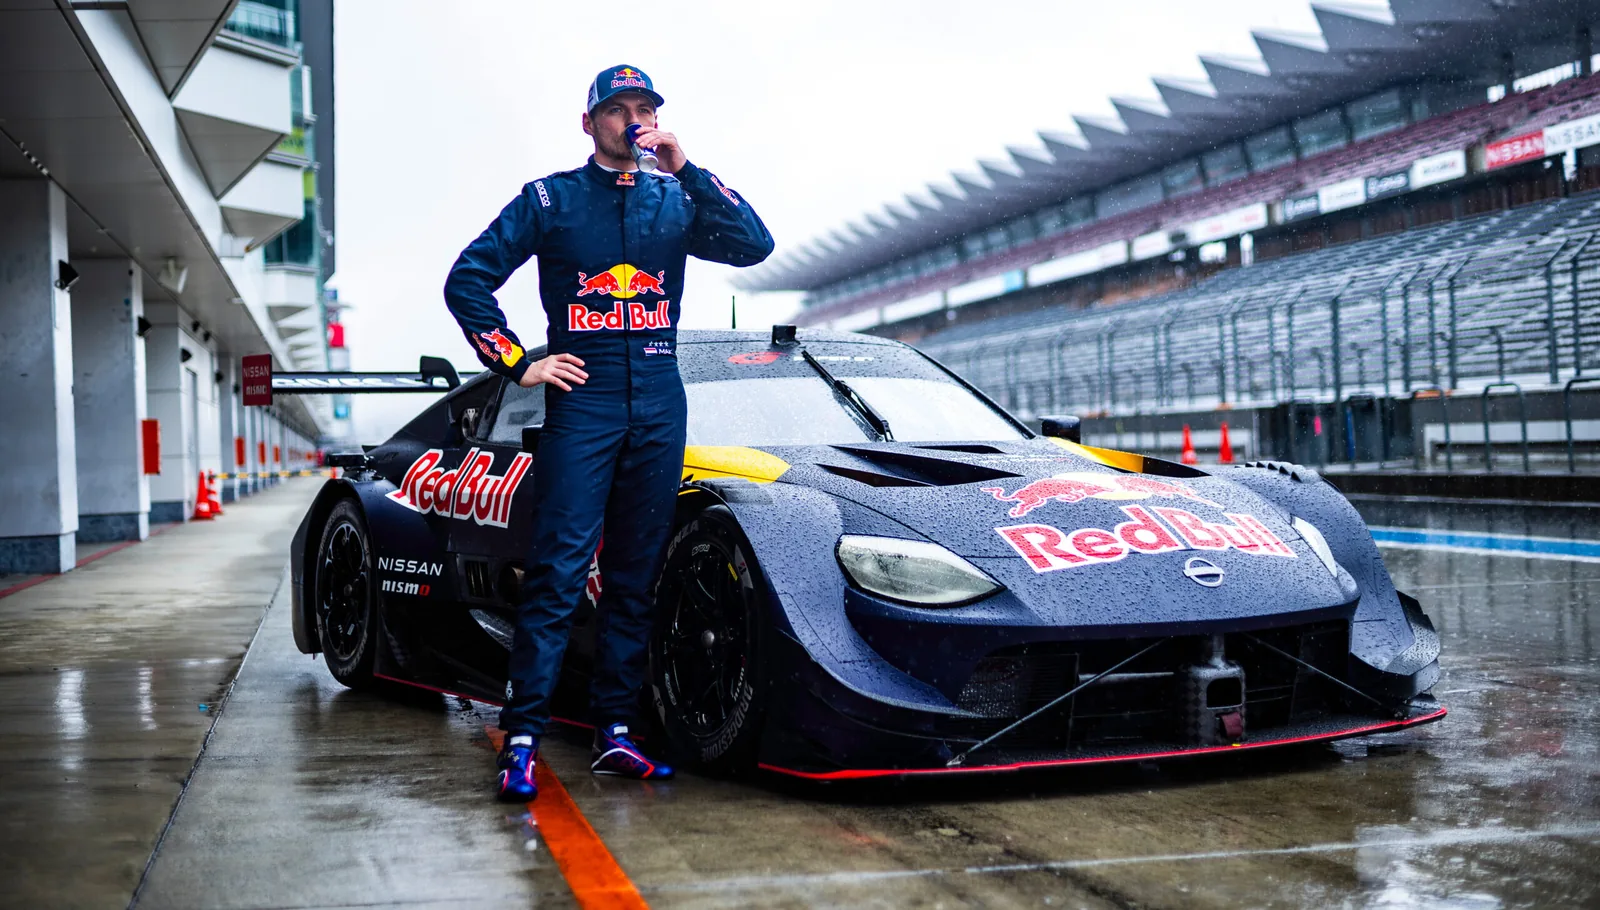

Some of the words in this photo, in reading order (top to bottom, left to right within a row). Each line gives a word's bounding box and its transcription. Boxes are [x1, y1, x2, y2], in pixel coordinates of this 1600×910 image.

[611, 78, 630, 89] Red
[630, 79, 647, 89] Bull
[1547, 122, 1600, 145] NISSA
[1486, 136, 1545, 162] NISSAN
[568, 301, 625, 331] Red
[628, 300, 671, 330] Bull
[243, 365, 270, 378] NISSAN
[385, 447, 480, 518] Red
[453, 450, 533, 528] Bull
[994, 504, 1186, 573] Red
[1148, 506, 1299, 558] Bull
[378, 556, 443, 577] NISSAN
[381, 579, 431, 597] nismo
